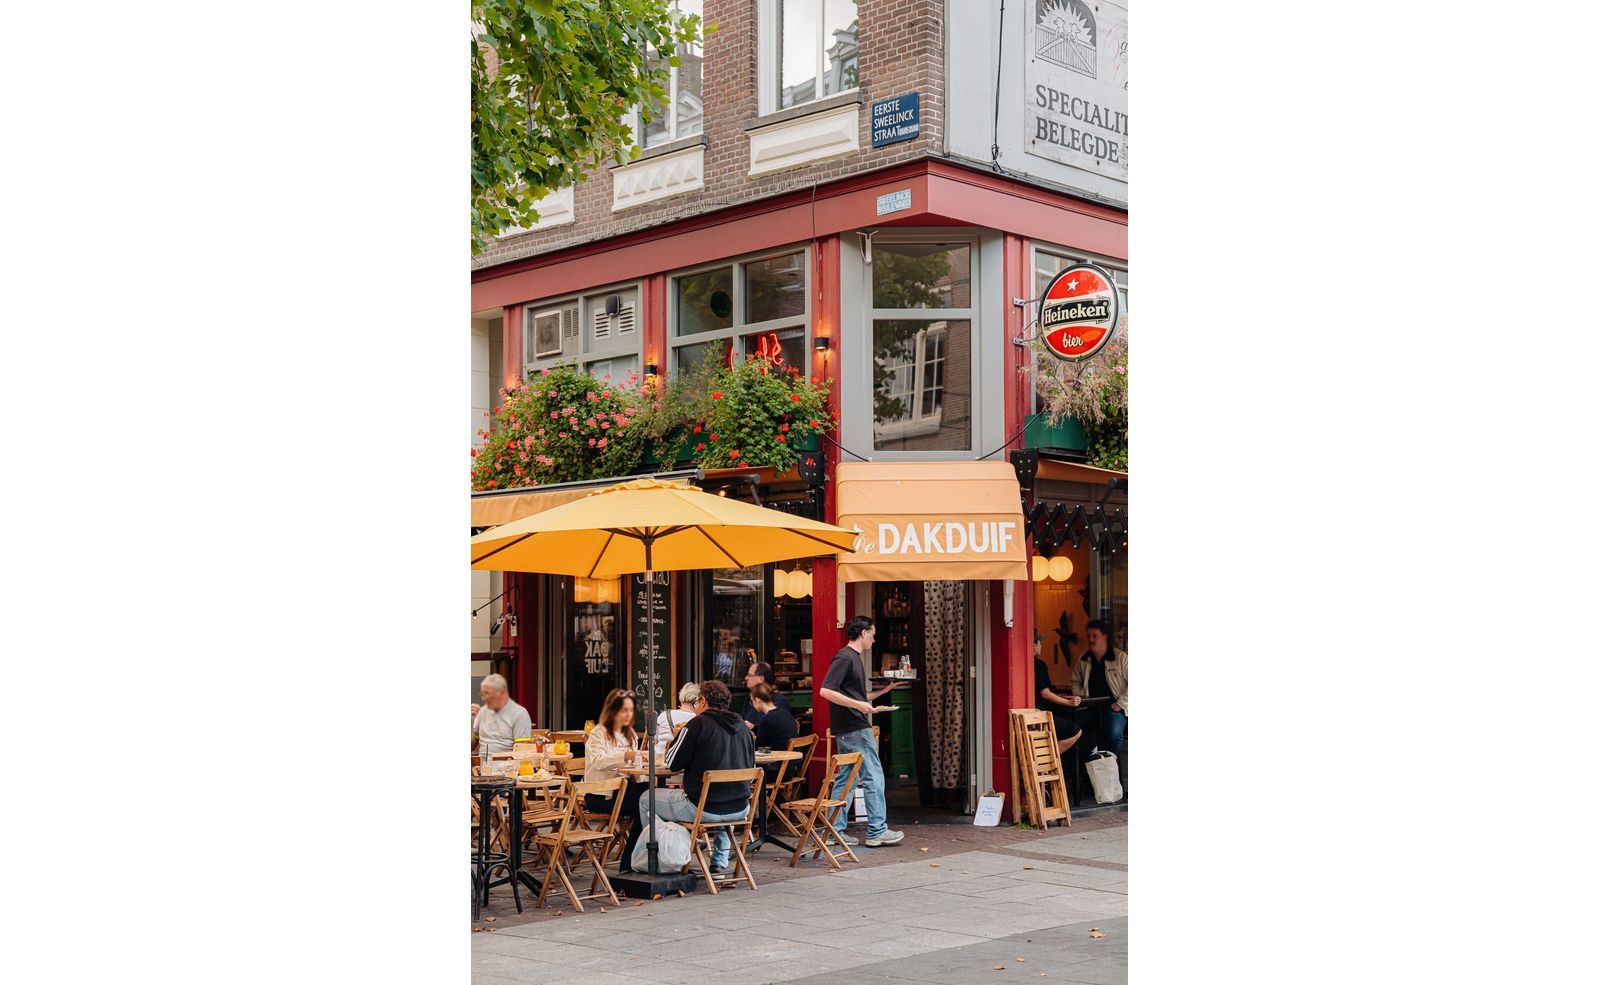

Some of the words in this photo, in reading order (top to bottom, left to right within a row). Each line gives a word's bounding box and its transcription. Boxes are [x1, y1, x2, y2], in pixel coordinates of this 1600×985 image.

[874, 100, 900, 116] EERSTE
[874, 109, 914, 129] SWEELINCK
[874, 125, 900, 141] STRAAT
[1036, 116, 1119, 163] BELEGDE
[1045, 303, 1107, 325] Heineken
[1063, 332, 1083, 348] bier
[879, 522, 1016, 554] DAKDUIF
